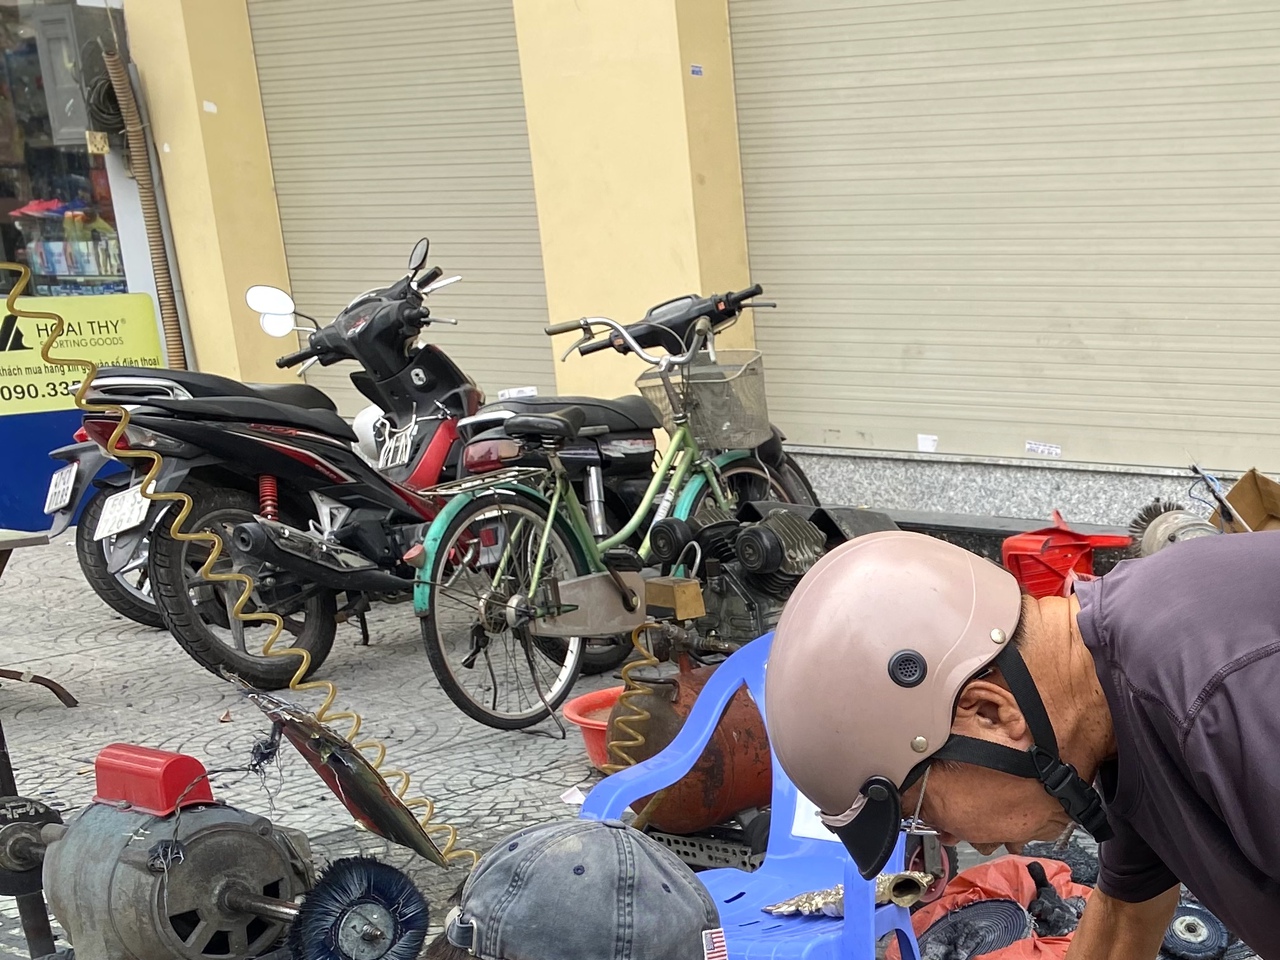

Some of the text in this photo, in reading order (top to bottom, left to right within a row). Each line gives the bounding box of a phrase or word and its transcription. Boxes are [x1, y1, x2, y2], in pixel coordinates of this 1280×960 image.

[40, 336, 124, 349] SORTING GOODS
[25, 366, 42, 376] mua
[0, 380, 82, 401] 090.33
